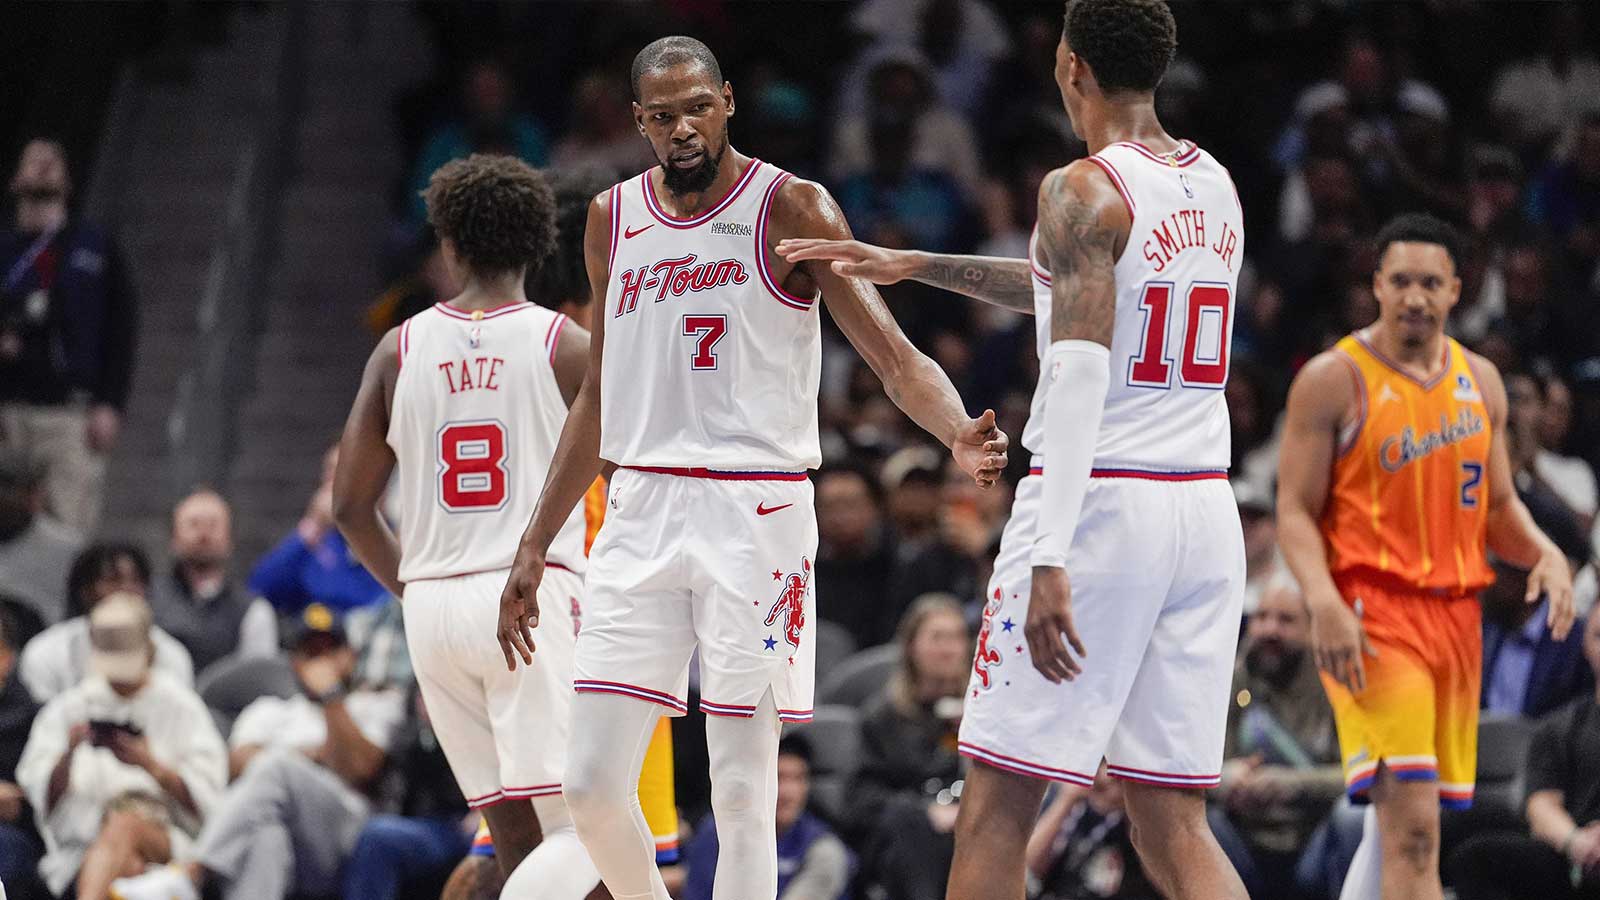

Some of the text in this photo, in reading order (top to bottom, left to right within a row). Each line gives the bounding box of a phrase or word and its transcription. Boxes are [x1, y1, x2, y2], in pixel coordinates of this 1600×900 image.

[710, 228, 752, 236] HERMANN
[711, 222, 752, 231] MEMORIAL
[1143, 209, 1237, 273] SMITH JR
[614, 253, 749, 318] H-Town
[682, 314, 727, 370] 7
[1126, 280, 1232, 390] 10
[438, 356, 504, 394] TATE
[436, 418, 511, 514] 8
[1459, 460, 1484, 507] 2
